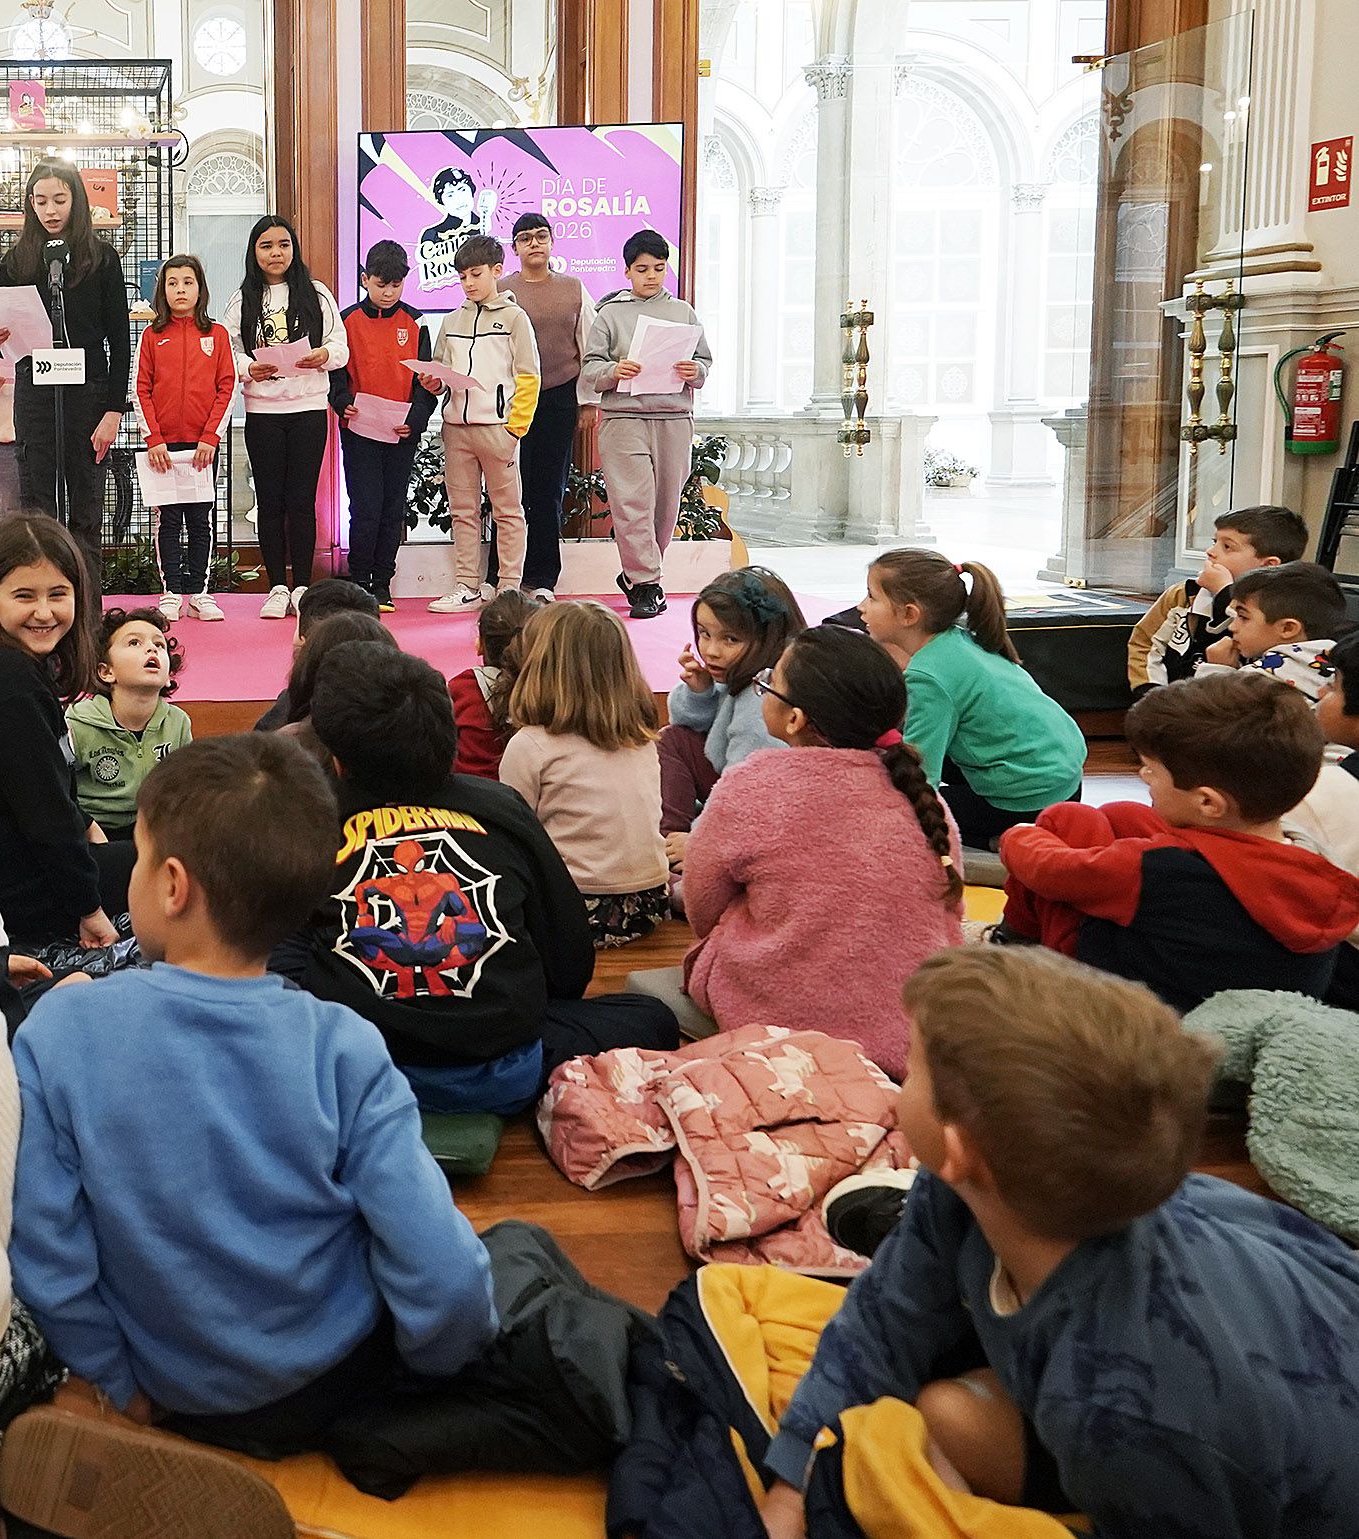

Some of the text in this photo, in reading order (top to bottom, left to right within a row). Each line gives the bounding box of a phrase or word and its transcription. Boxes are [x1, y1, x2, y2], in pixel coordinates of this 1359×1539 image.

[542, 174, 607, 196] DÍA DE
[542, 188, 652, 218] ROSALÍA
[1312, 193, 1347, 205] EXTINTOR
[552, 221, 592, 239] 026
[570, 257, 617, 266] Deputación
[570, 265, 617, 273] Pontevedra
[335, 805, 489, 864] SPIDER-MAN
